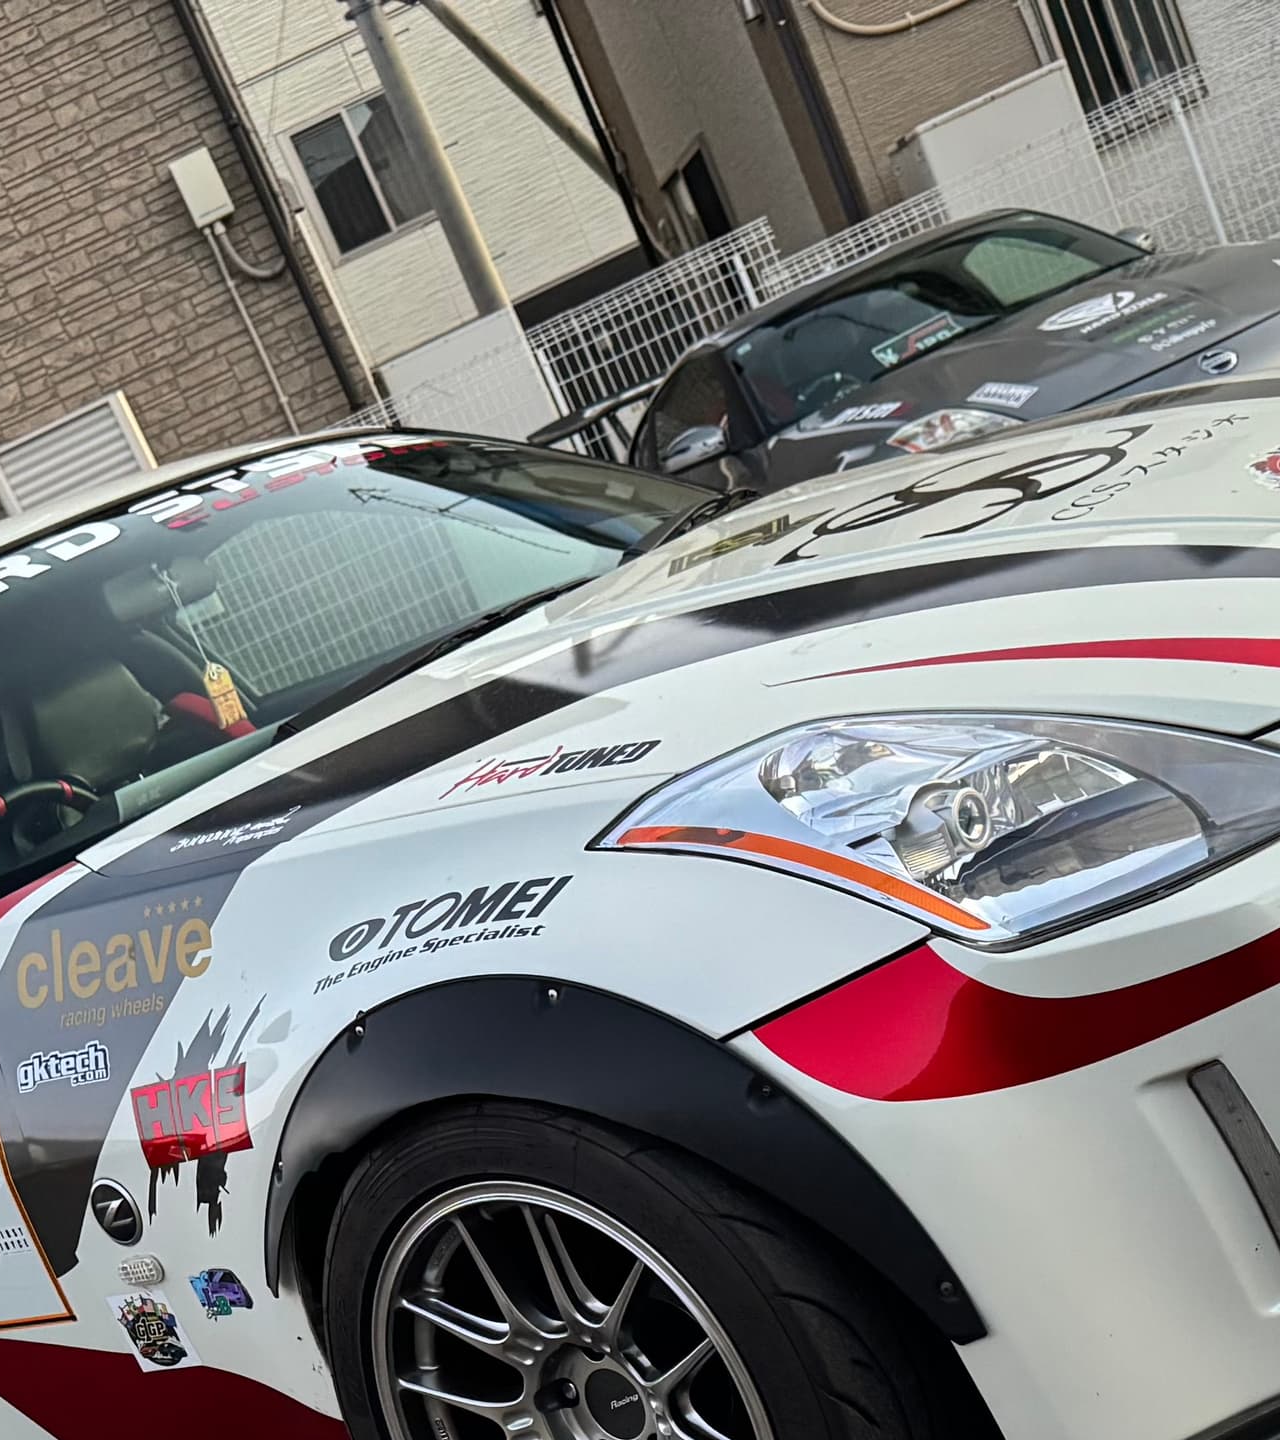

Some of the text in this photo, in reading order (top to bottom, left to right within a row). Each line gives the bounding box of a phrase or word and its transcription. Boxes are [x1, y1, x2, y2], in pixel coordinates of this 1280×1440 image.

[379, 875, 573, 949] TOMEI
[17, 917, 213, 1009] cleave
[313, 925, 546, 994] The Engine Specialist
[60, 992, 164, 1029] racing wheels
[18, 1042, 109, 1090] gktech
[136, 1072, 243, 1141] HKS
